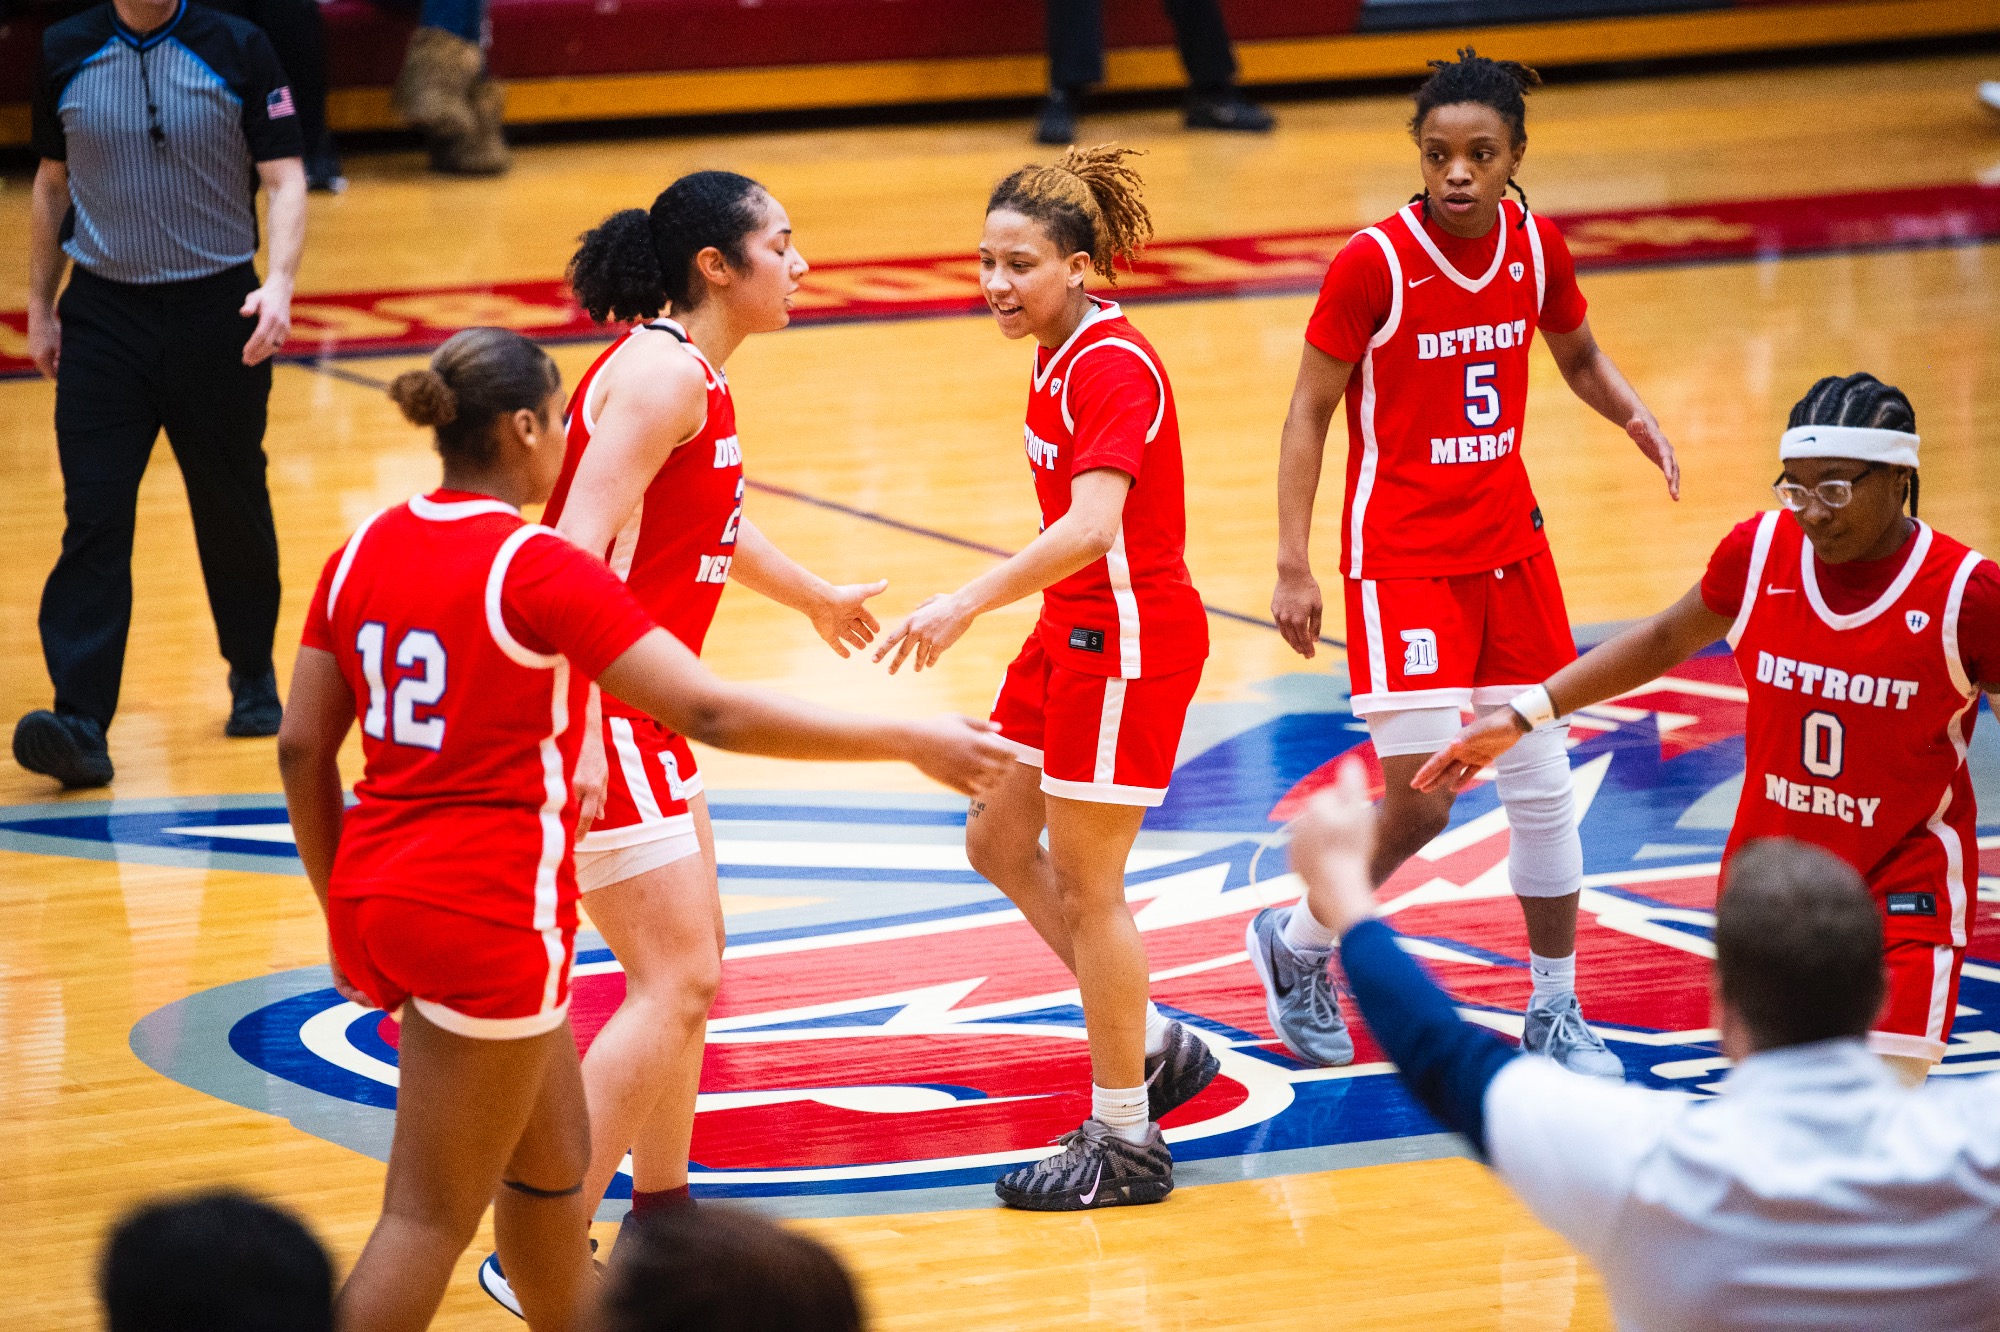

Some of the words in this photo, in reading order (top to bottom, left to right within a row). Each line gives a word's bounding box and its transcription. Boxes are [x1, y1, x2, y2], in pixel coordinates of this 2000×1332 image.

[1463, 361, 1502, 429] 5
[712, 434, 743, 469] DE
[1430, 426, 1516, 465] MERCY
[1091, 636, 1098, 646] S
[354, 619, 448, 754] 12
[1755, 649, 1920, 711] DETROIT
[1800, 708, 1846, 780] 0
[1764, 772, 1882, 828] MERCY
[1921, 898, 1929, 909] L
